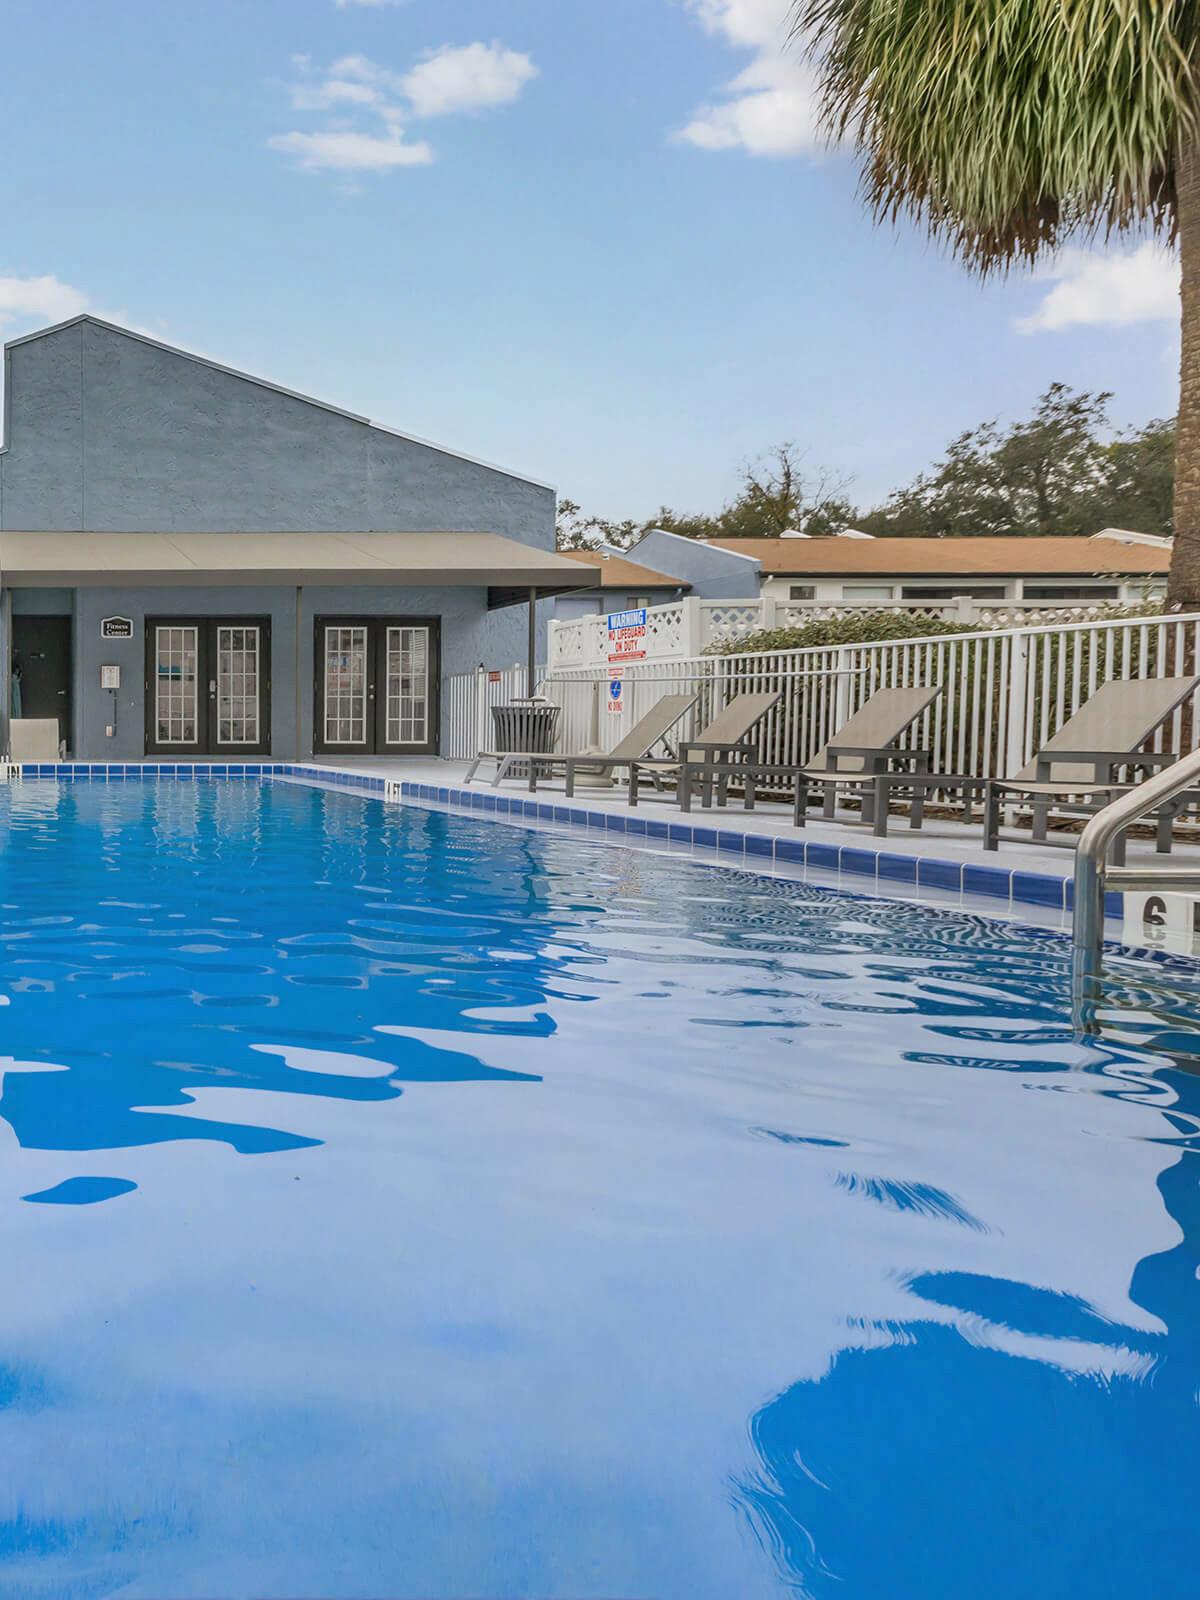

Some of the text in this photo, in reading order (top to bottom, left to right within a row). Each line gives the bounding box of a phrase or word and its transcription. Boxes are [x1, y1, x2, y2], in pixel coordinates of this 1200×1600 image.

[610, 611, 643, 628] WARNING
[609, 626, 646, 641] NO LIFEGUARD
[615, 640, 638, 652] ON DUTY
[7, 766, 20, 778] IN
[1143, 895, 1167, 926] 6
